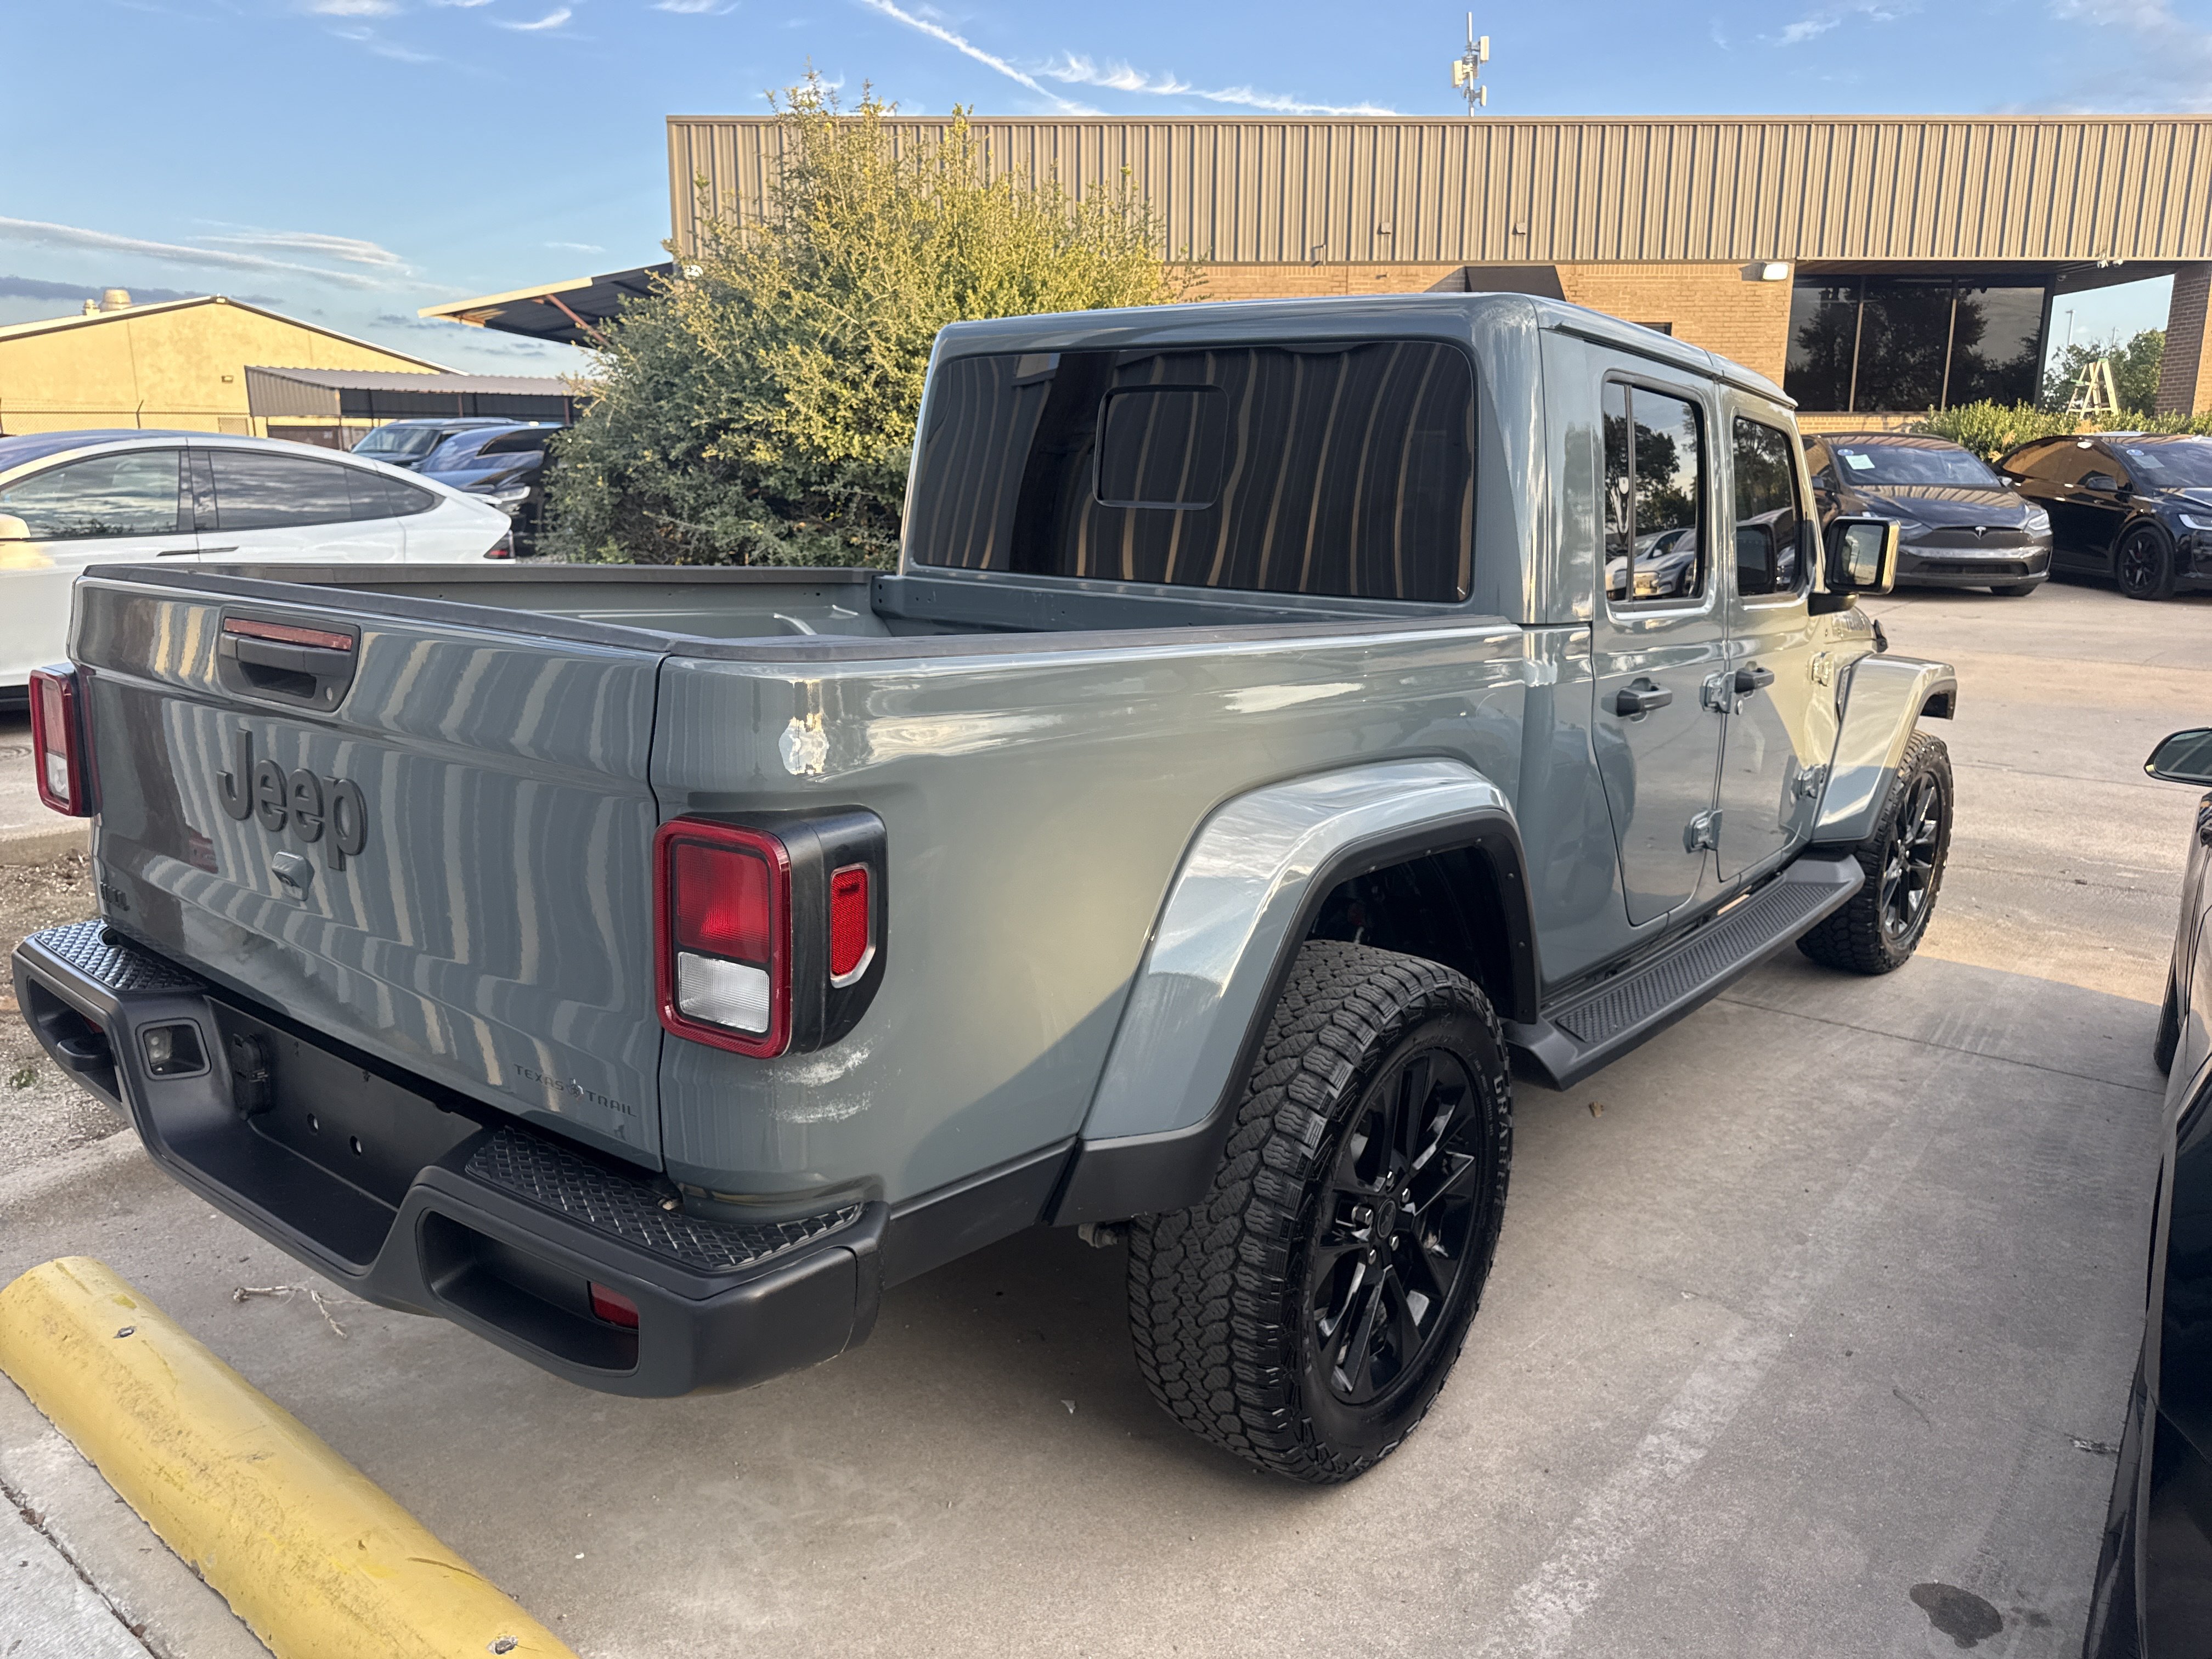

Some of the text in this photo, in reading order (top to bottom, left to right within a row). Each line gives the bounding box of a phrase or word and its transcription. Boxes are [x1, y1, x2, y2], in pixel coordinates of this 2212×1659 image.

[217, 728, 368, 871] Jeep
[514, 1064, 637, 1118] TEXAS TRAIL
